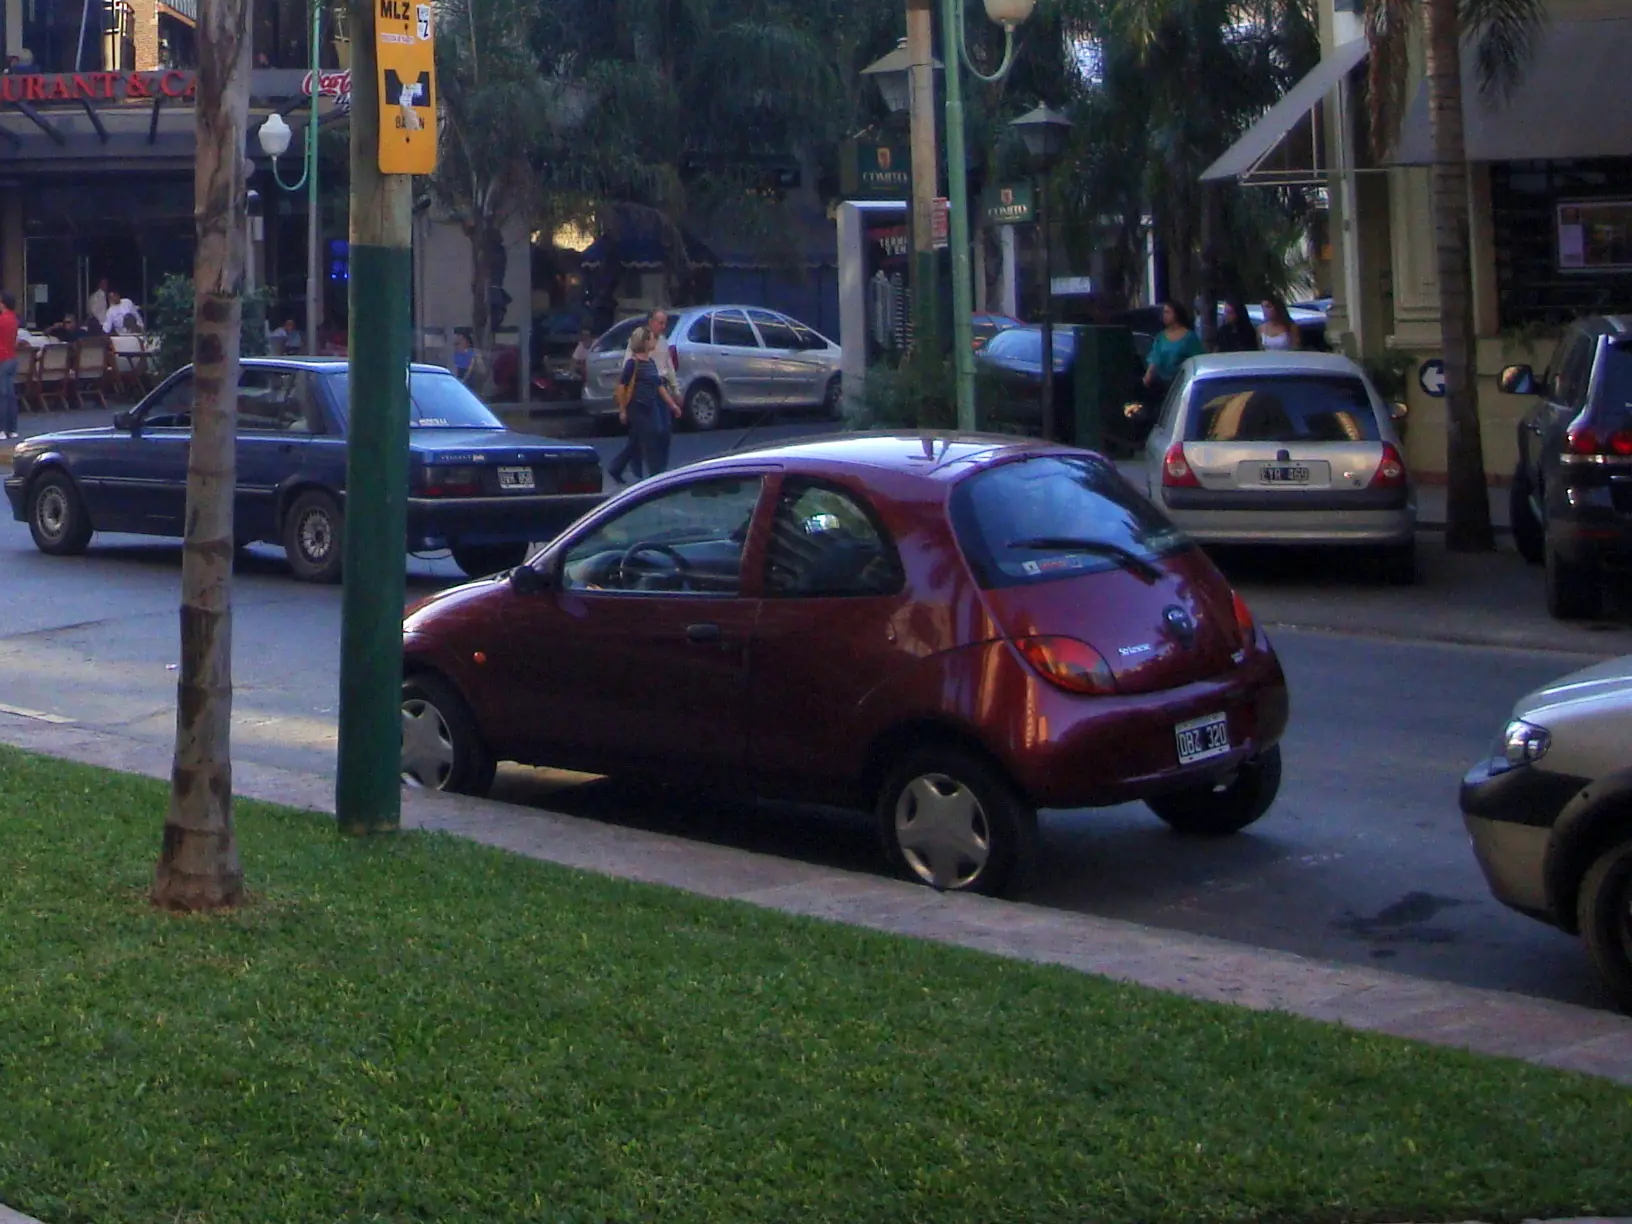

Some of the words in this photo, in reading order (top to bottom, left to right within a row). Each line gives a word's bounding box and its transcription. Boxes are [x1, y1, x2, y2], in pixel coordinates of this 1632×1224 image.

[380, 0, 410, 21] MLZ
[126, 71, 152, 97] &
[395, 115, 425, 130] BAN
[1179, 729, 1202, 756] DBZ
[1206, 723, 1227, 748] 320
